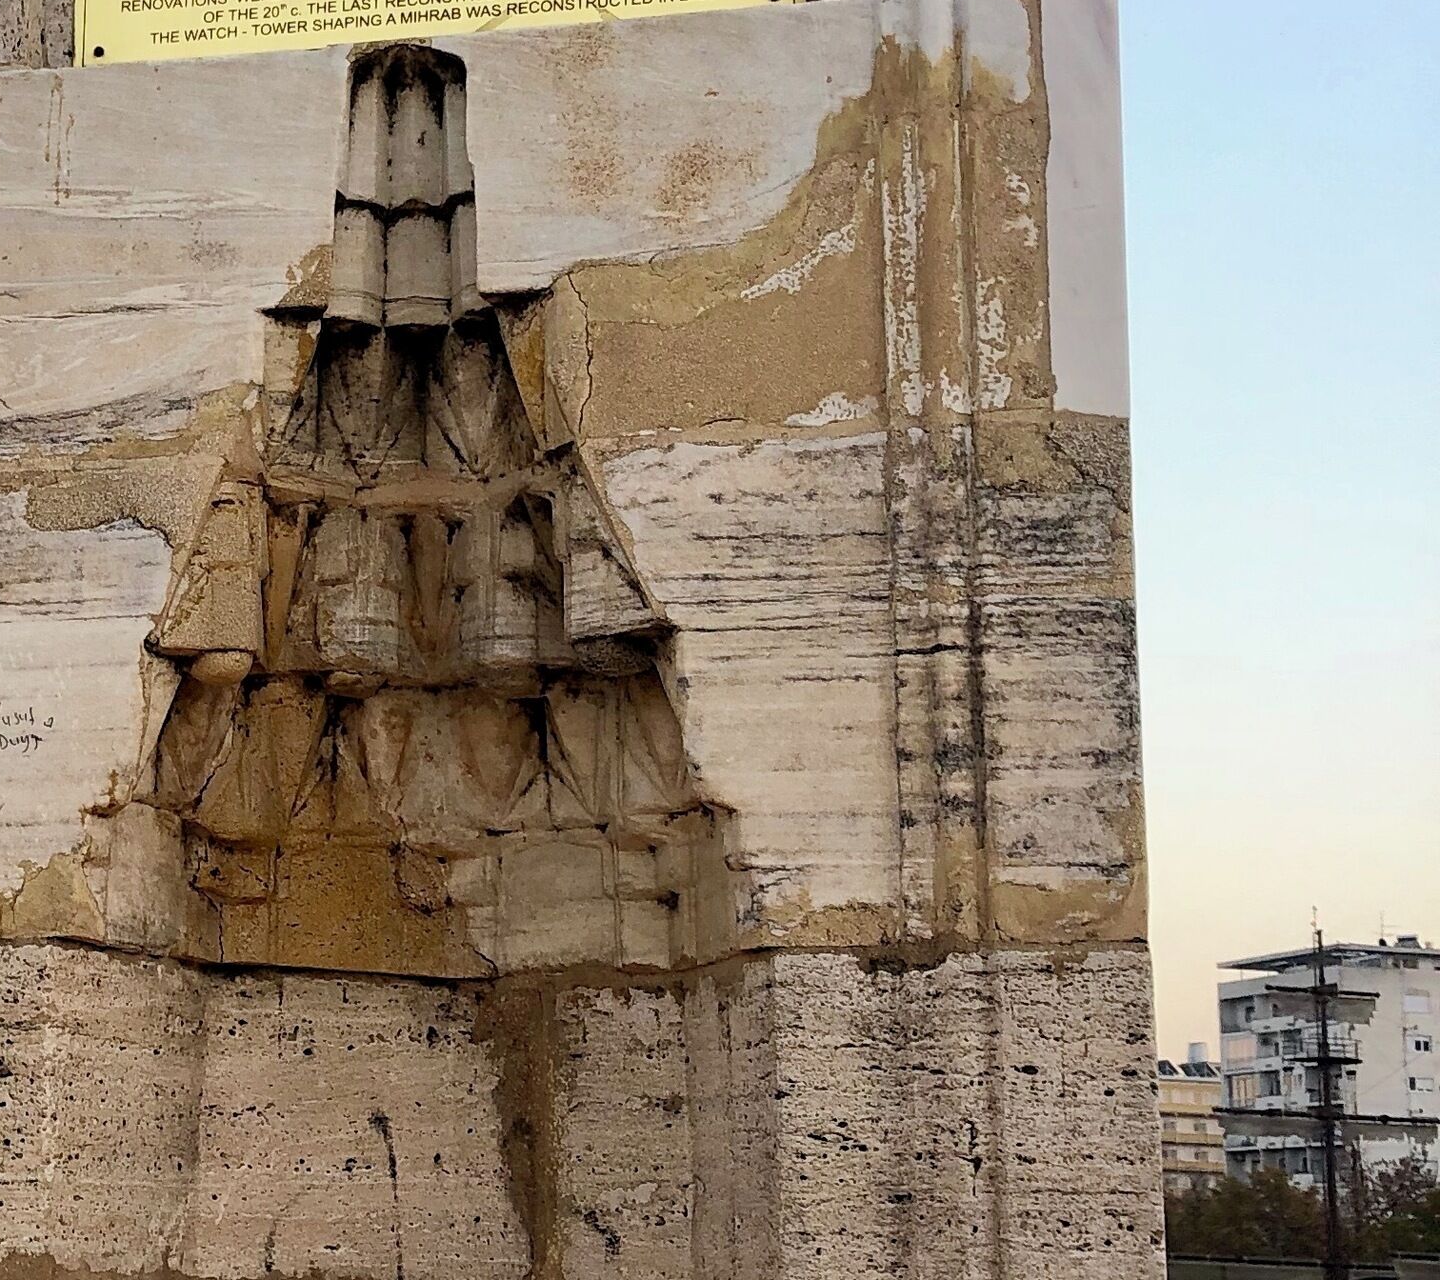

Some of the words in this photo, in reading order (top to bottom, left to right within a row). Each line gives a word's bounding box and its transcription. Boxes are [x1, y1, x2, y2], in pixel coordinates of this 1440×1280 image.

[150, 30, 179, 43] THE
[184, 26, 237, 41] WATCH
[251, 20, 307, 35] TOWER
[312, 14, 381, 31] SHAPING
[385, 13, 396, 25] A
[400, 7, 461, 23] MIHRAB
[465, 4, 504, 18] WAS
[203, 10, 224, 23] OF
[228, 7, 258, 20] THE
[306, 0, 336, 14] THE
